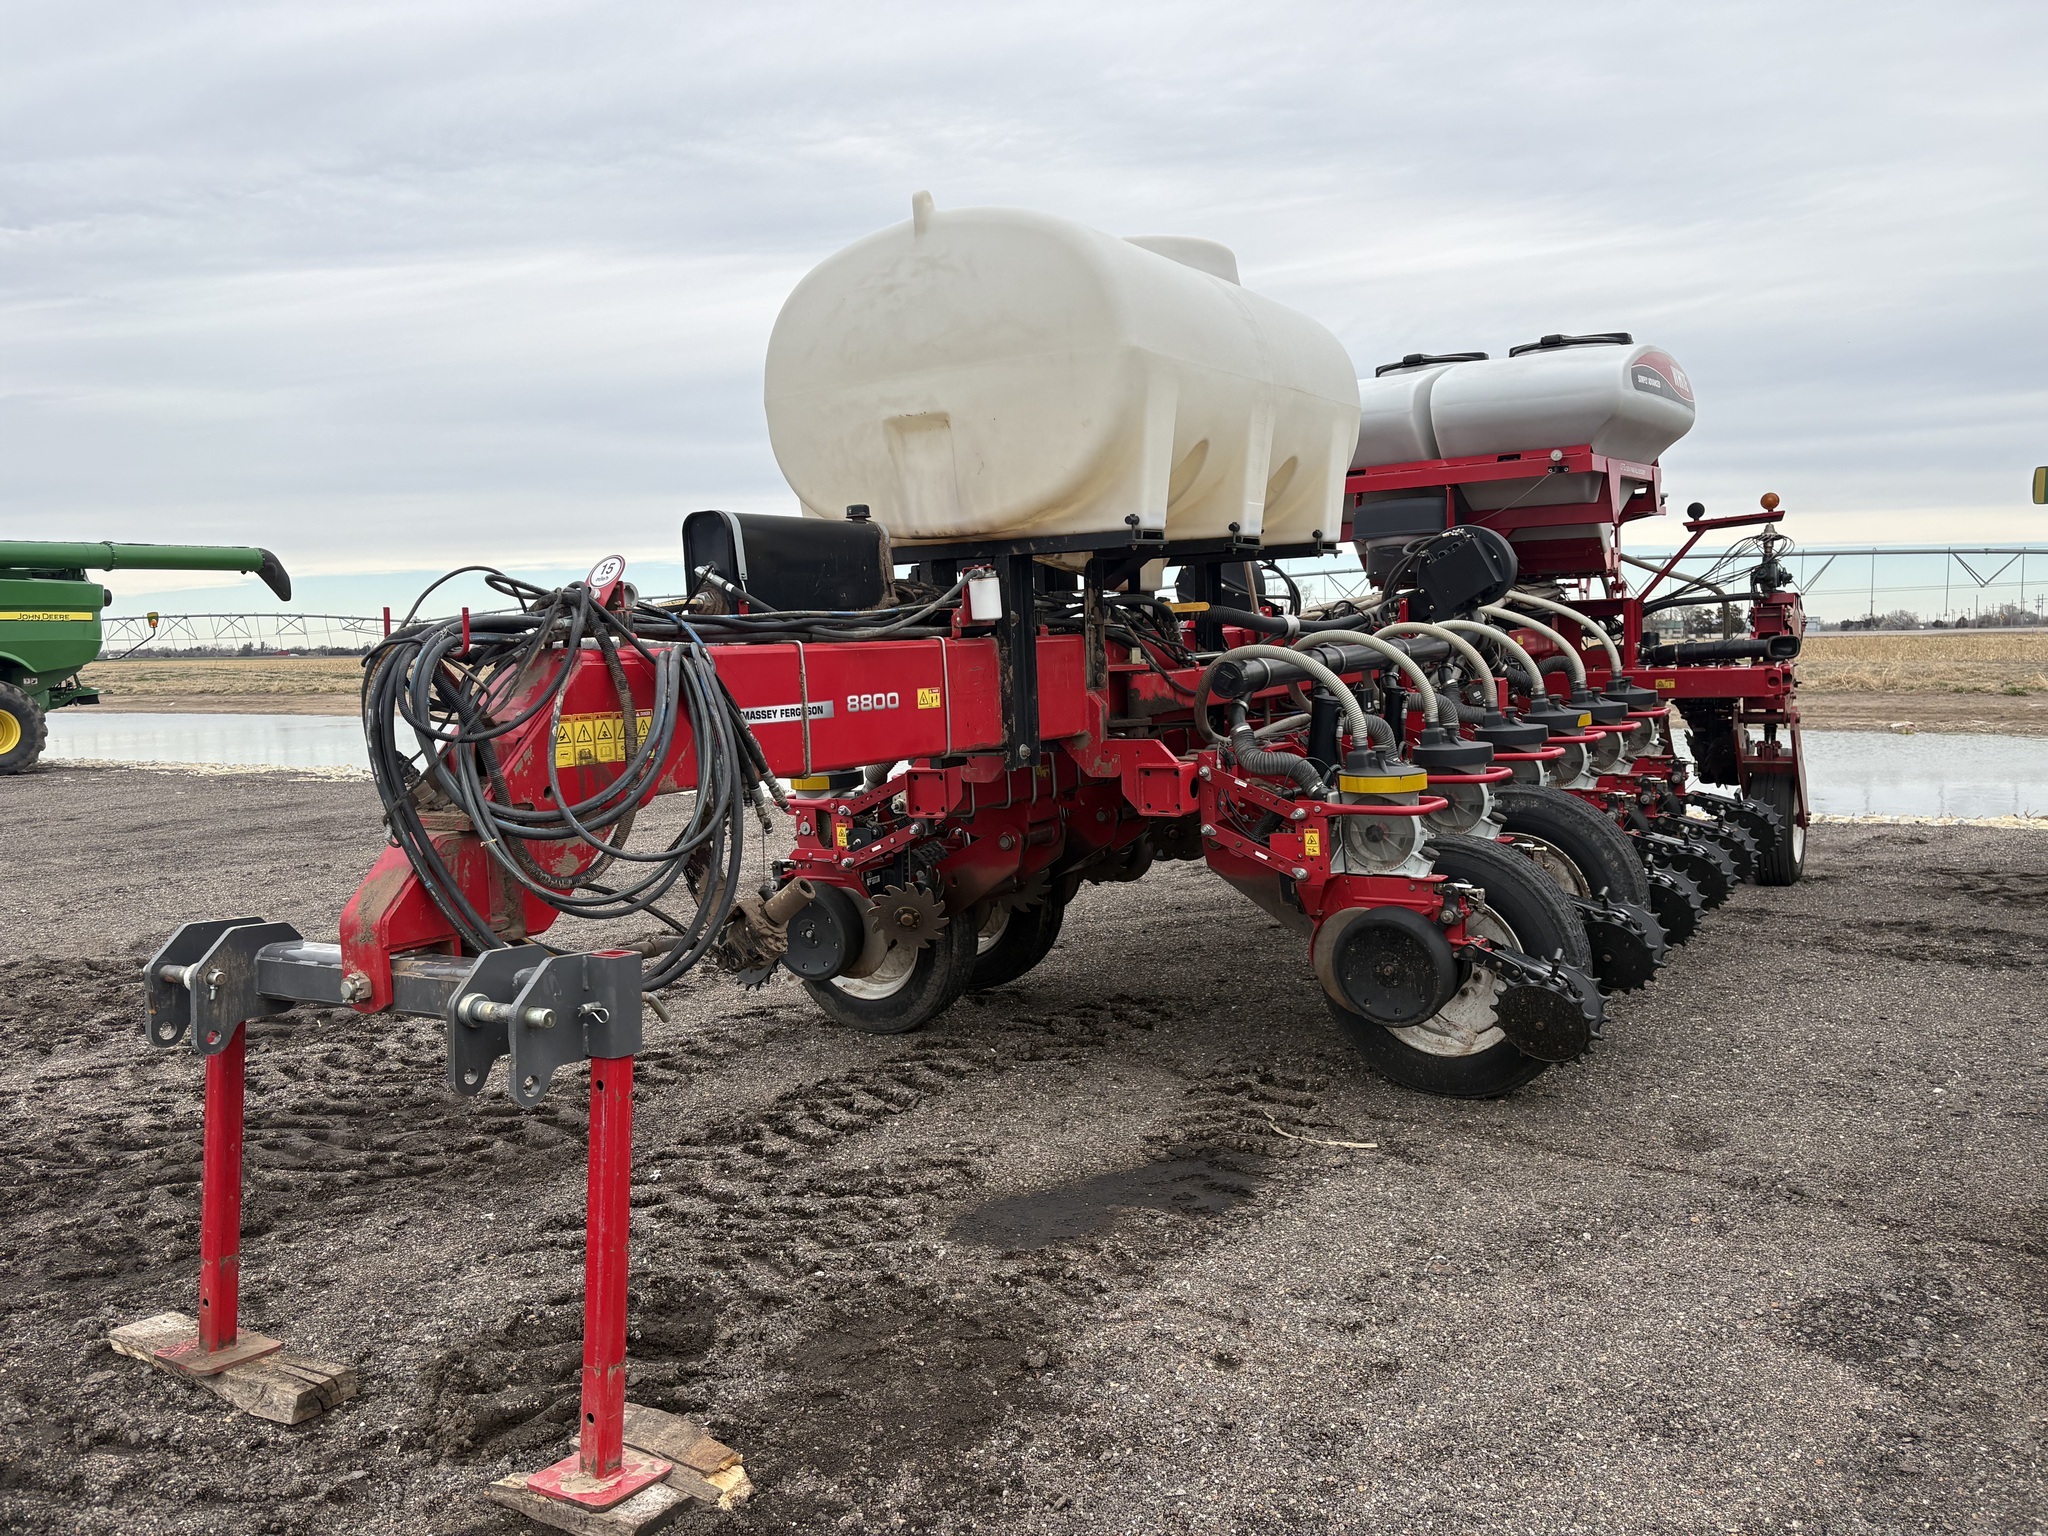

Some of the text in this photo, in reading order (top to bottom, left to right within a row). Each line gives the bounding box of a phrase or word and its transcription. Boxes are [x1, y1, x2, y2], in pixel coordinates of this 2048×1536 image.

[600, 562, 616, 575] 15
[847, 692, 899, 712] 8800
[742, 705, 824, 721] MASSEY FERGSON
